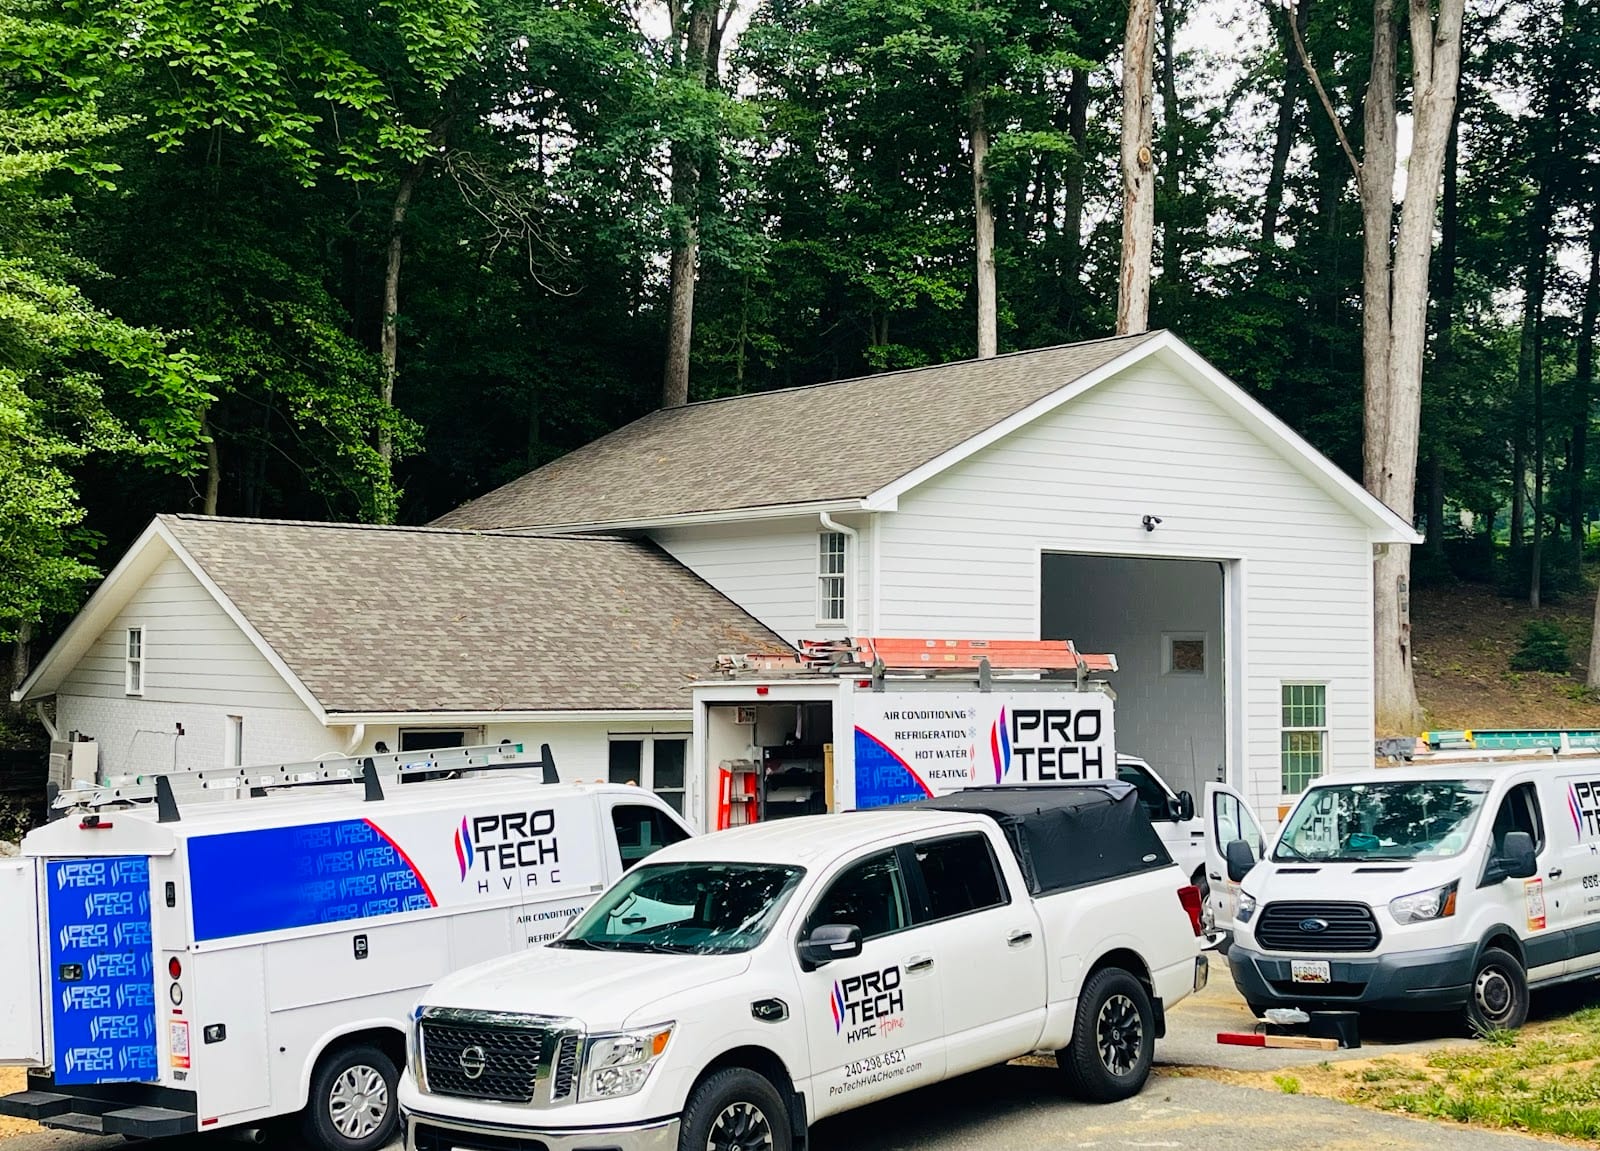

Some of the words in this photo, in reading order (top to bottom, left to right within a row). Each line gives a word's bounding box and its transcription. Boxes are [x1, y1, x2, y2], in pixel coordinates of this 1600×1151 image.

[883, 711, 899, 720] AIR
[902, 710, 967, 720] CONDITIONING
[1012, 709, 1101, 743] PRO
[895, 730, 967, 740] REFRIGERATION
[915, 750, 933, 759] HOT
[936, 749, 967, 760] WATER
[1013, 746, 1103, 781] TECH
[929, 769, 968, 779] HEATING
[473, 809, 555, 843] PRO
[344, 832, 373, 844] TECH
[364, 846, 394, 858] PRO
[475, 837, 559, 872] TECH
[120, 861, 149, 873] PR
[365, 856, 394, 868] TECH
[65, 863, 105, 876] PRO
[387, 869, 416, 882] PRO
[66, 874, 106, 887] TECH
[345, 874, 376, 887] PRO
[387, 878, 417, 891] TECH
[478, 870, 561, 894] HVAC
[346, 884, 377, 897] TECH
[93, 892, 133, 905] PRO
[368, 898, 398, 910] PRO
[408, 894, 430, 905] PR
[94, 903, 133, 916] TECH
[516, 915, 532, 924] AIR
[68, 924, 108, 937] PRO
[122, 922, 150, 935] PR
[70, 935, 108, 948] TECH
[96, 953, 136, 966] PRO
[97, 965, 137, 978] TECH
[124, 983, 153, 995] PR
[841, 965, 901, 1002] PRO
[71, 985, 110, 998] PRO
[72, 996, 111, 1009] TECH
[845, 989, 904, 1025] TECH
[99, 1015, 138, 1028] PRO
[847, 1025, 876, 1044] HVAC
[879, 1012, 905, 1038] Home
[100, 1027, 138, 1039] TECH
[73, 1047, 113, 1060] PRO
[127, 1045, 156, 1058] PR
[74, 1058, 113, 1071] TECH
[845, 1049, 906, 1077] 240-298-6521
[829, 1062, 922, 1096] ProTechHVACHome.com
